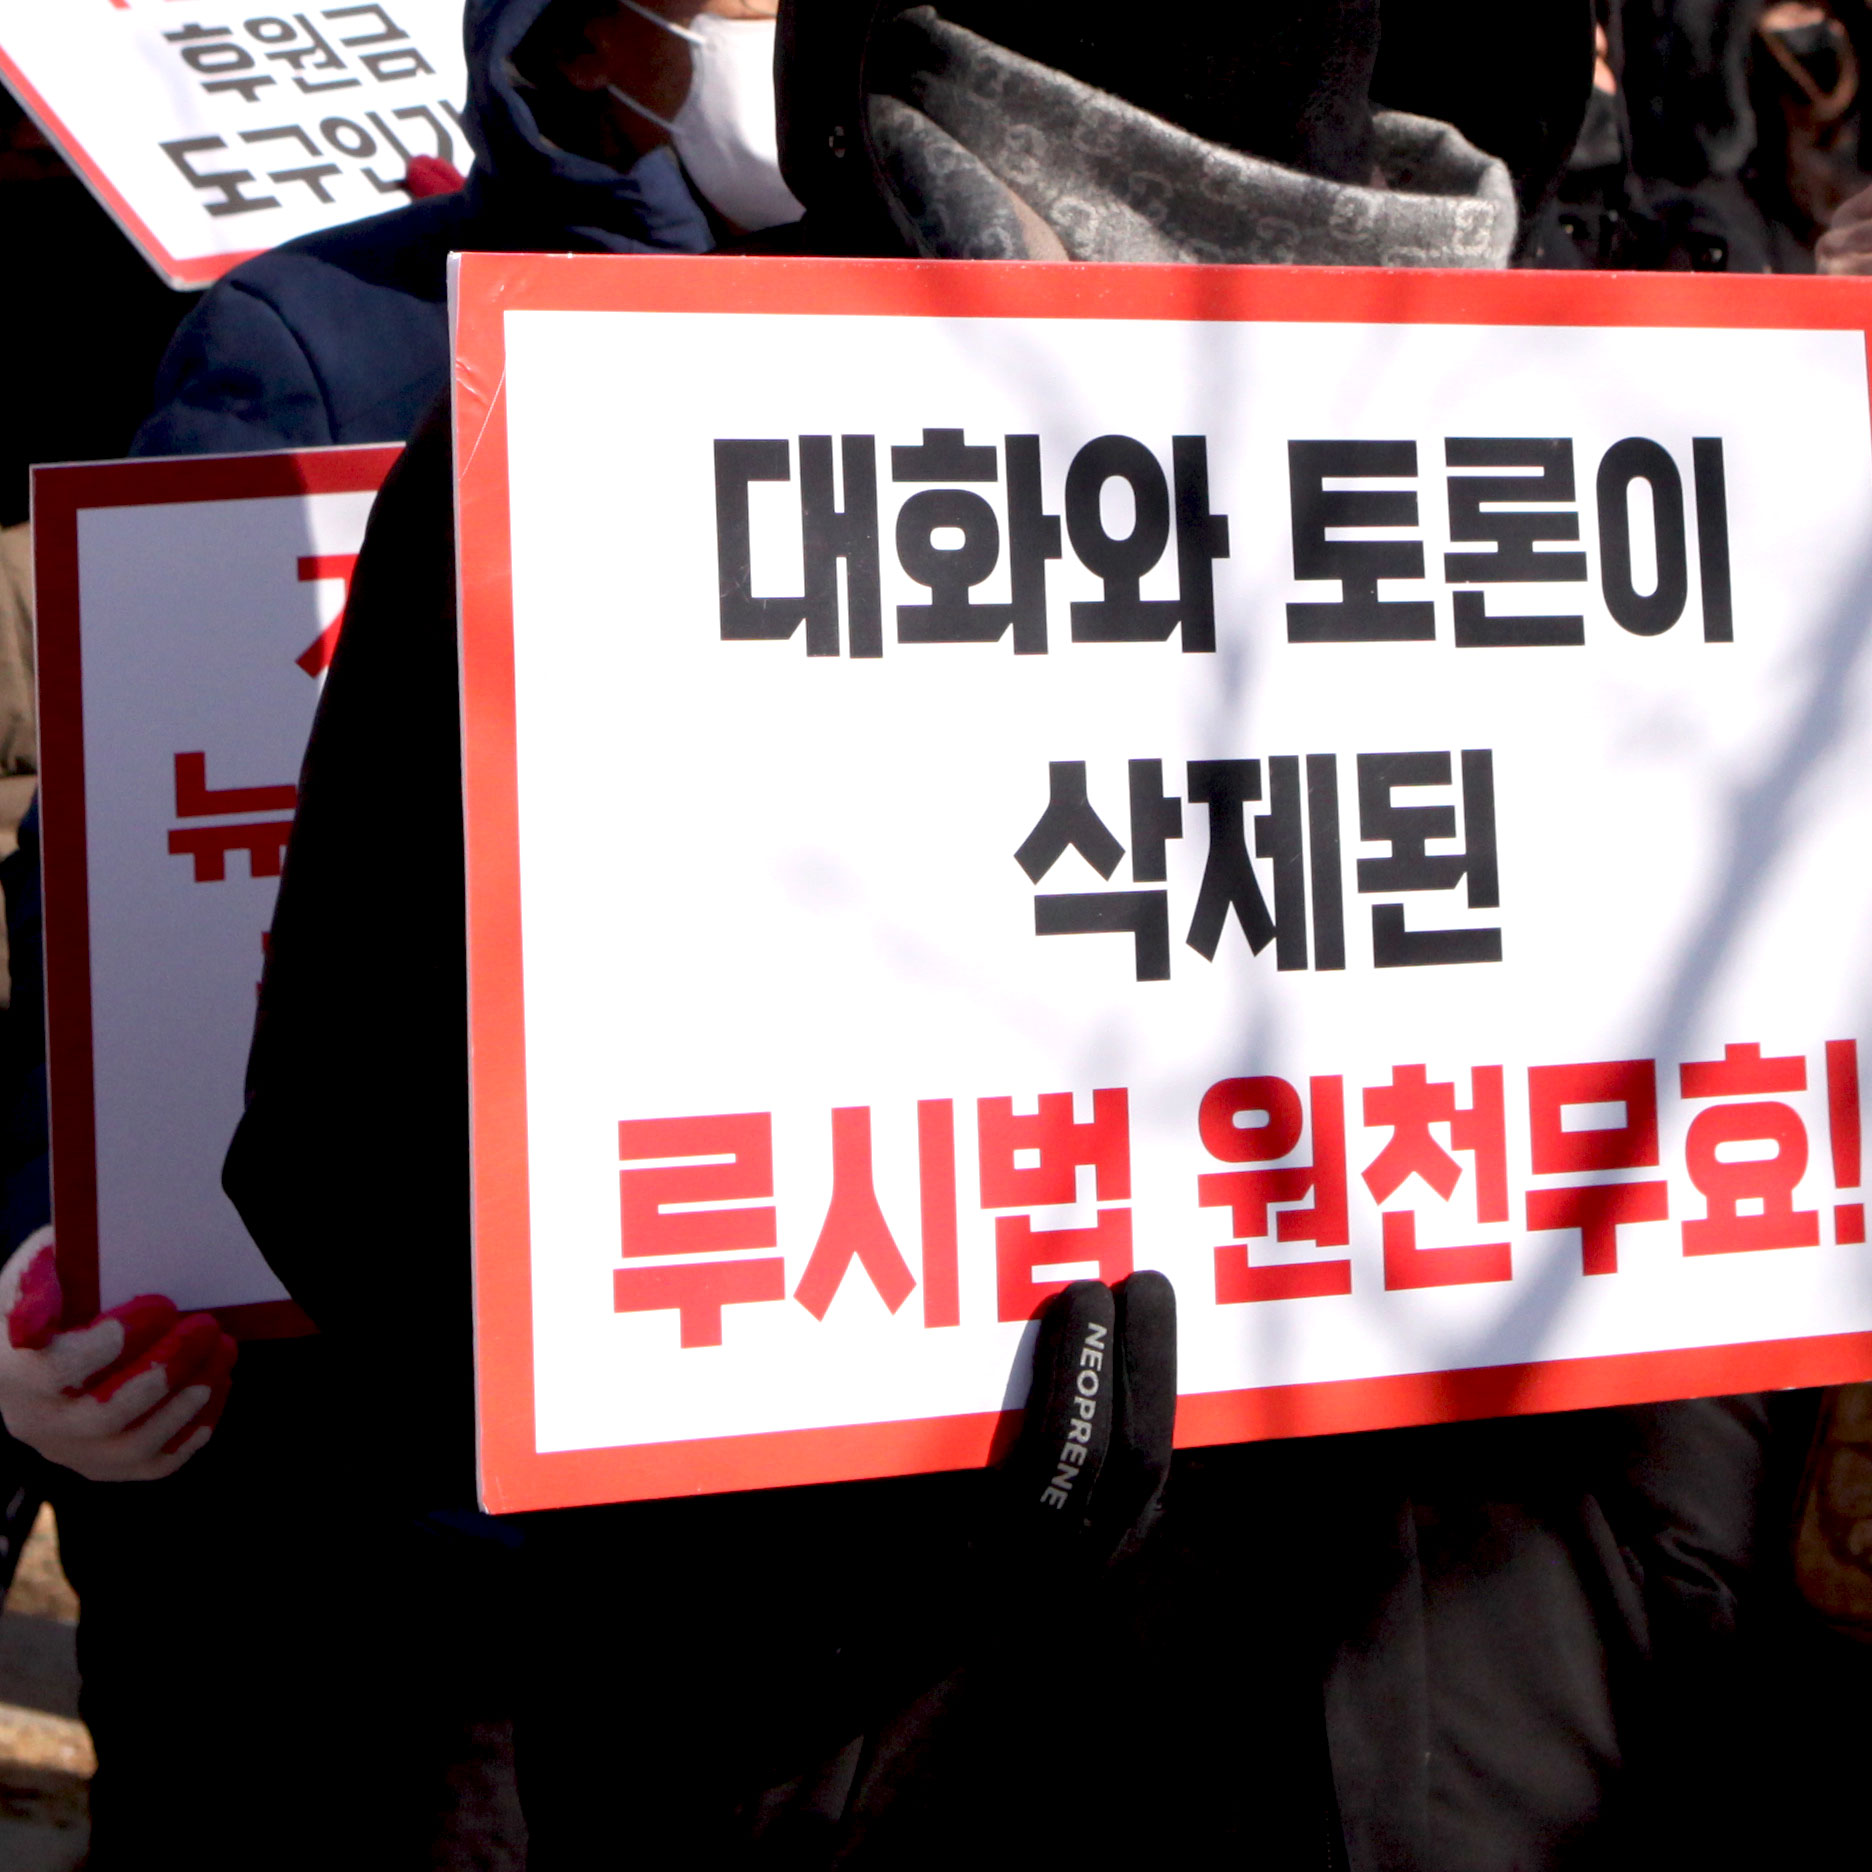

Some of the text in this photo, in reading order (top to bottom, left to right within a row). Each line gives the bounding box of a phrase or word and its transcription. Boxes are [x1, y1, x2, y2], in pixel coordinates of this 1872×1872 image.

[164, 3, 437, 103] 후원금
[712, 427, 1734, 659] 대화와 토론이
[1014, 748, 1503, 981] 삭제된
[613, 1038, 1867, 1349] 루시법 원천무효!
[1039, 1322, 1108, 1511] NEOPRENE
